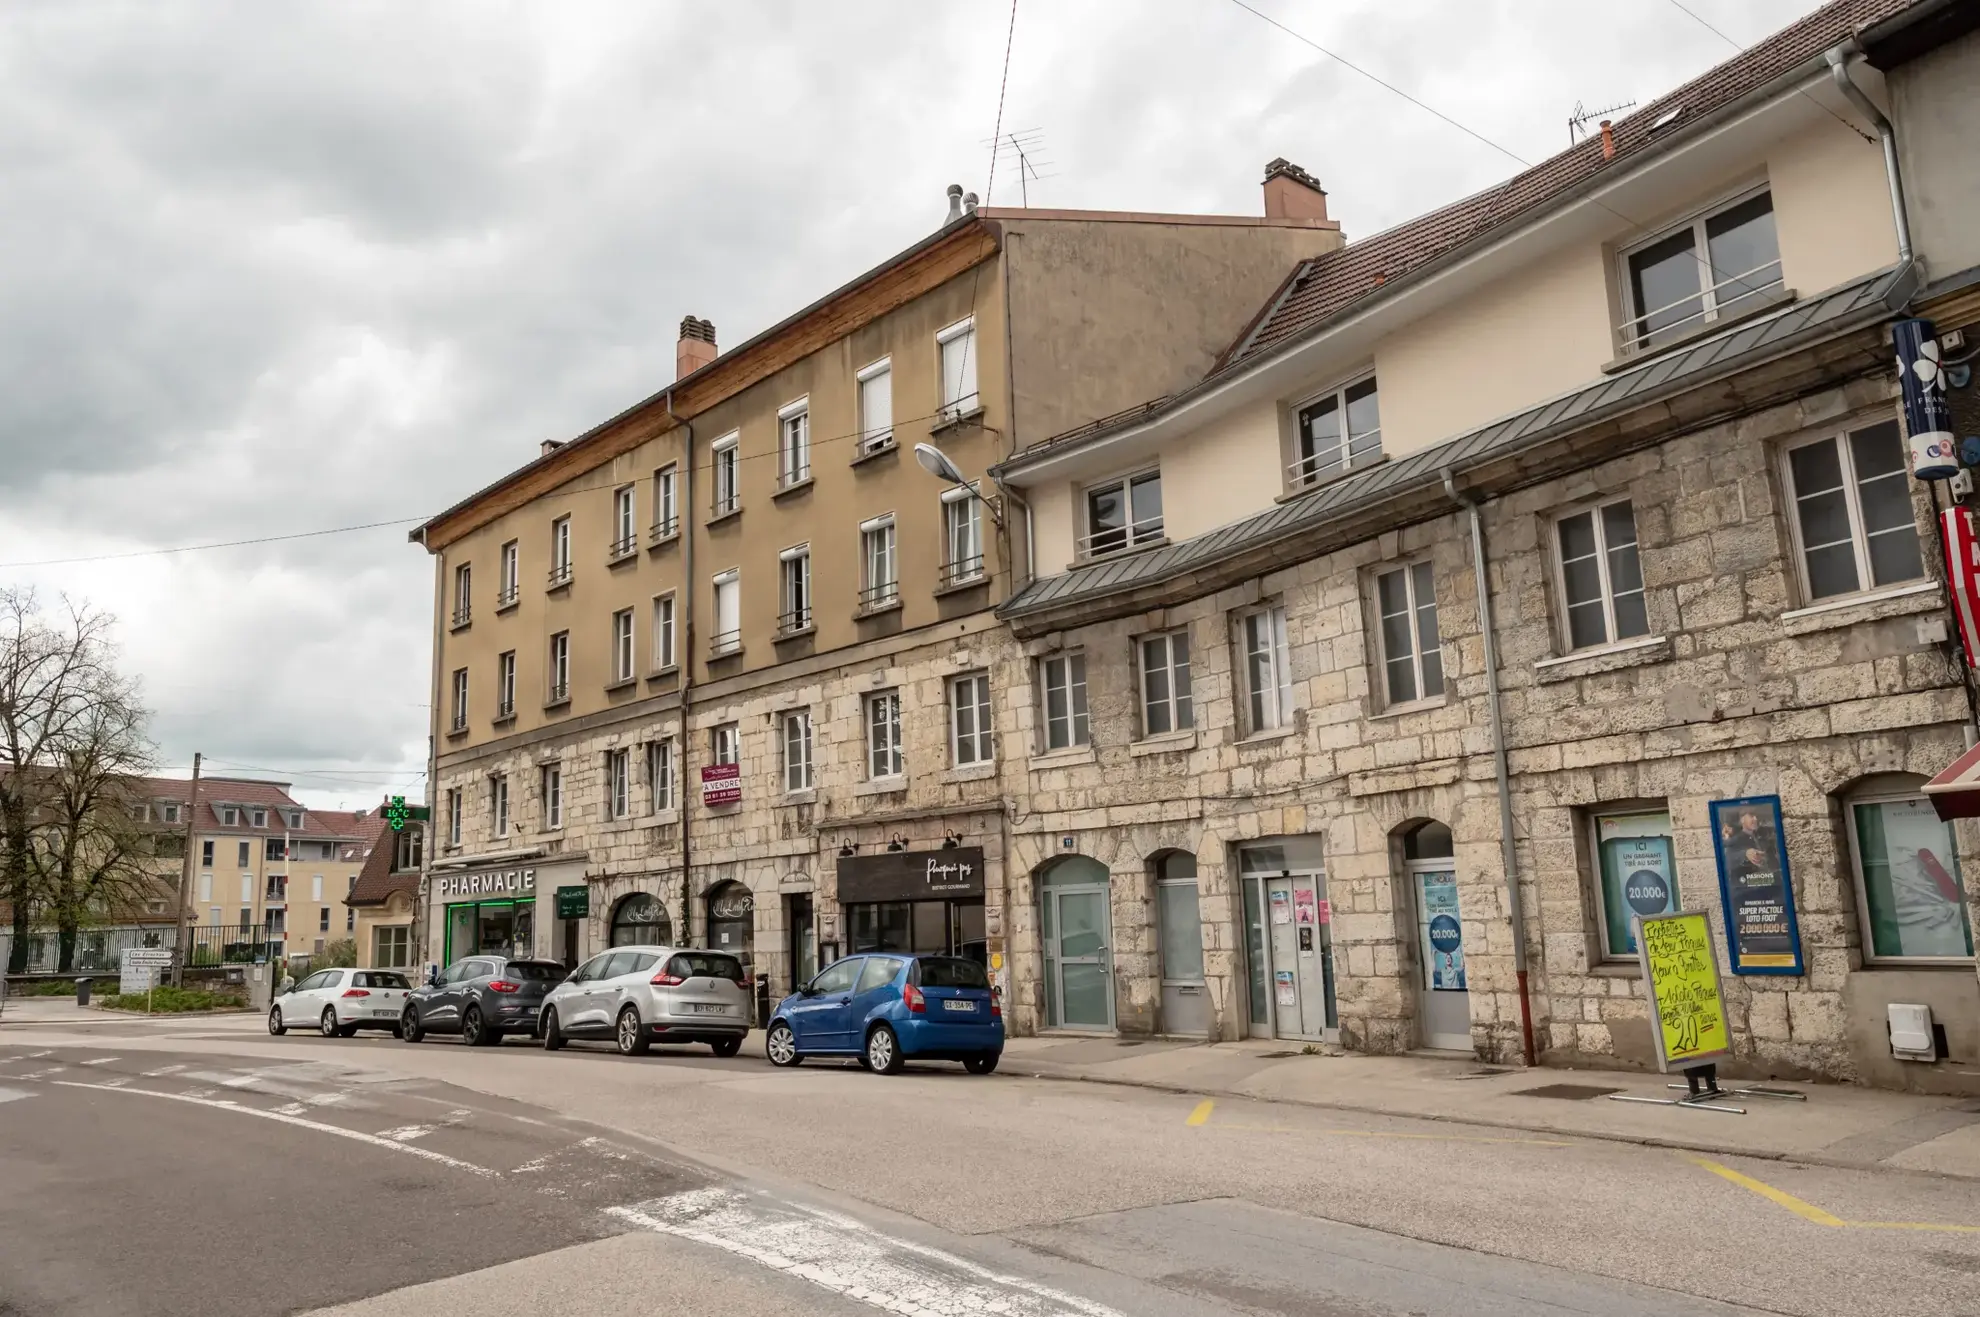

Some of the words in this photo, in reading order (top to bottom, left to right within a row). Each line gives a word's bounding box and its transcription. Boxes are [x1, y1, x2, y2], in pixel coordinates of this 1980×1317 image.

[710, 780, 739, 790] VENDRE
[1635, 842, 1647, 851] ICI
[440, 870, 534, 895] PHARMACIE
[1739, 907, 1758, 915] SUPER
[1758, 906, 1784, 914] PACTOLE
[1761, 914, 1778, 922] FOOT
[1672, 1015, 1699, 1051] 20
